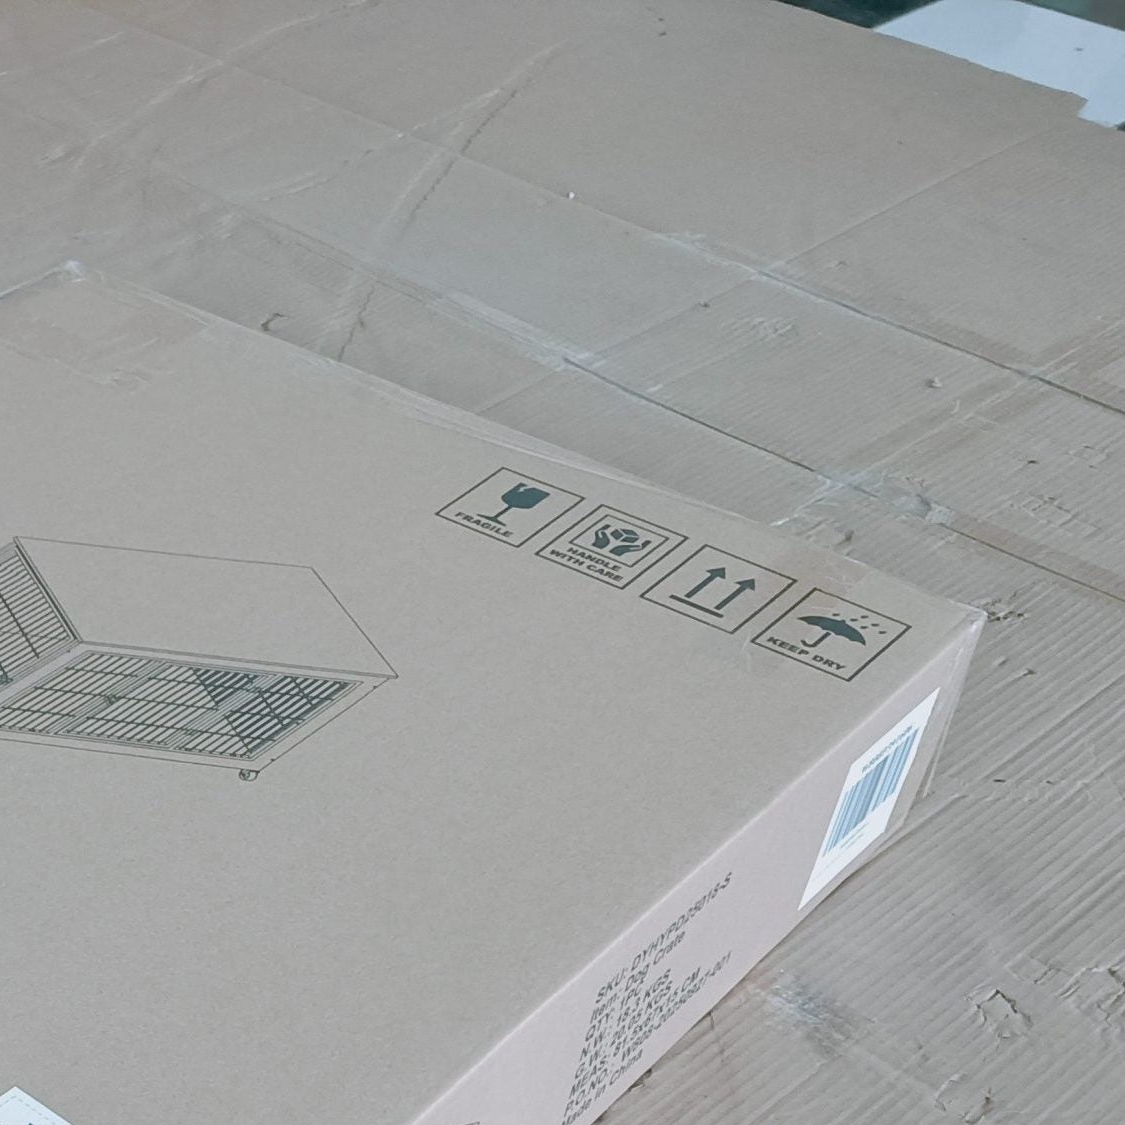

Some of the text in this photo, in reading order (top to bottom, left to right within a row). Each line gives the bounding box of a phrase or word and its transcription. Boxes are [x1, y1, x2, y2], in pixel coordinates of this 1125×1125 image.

[454, 511, 514, 538] FRAGILE
[549, 549, 624, 582] WITH CARE
[566, 546, 621, 572] HANDLE
[767, 637, 846, 671] KEEP DRY
[625, 963, 650, 991] Dog
[653, 931, 685, 965] Crate
[596, 967, 628, 1004] SKU:
[643, 968, 671, 1003] KGS
[644, 980, 673, 1014] KGS
[610, 1049, 643, 1086] China
